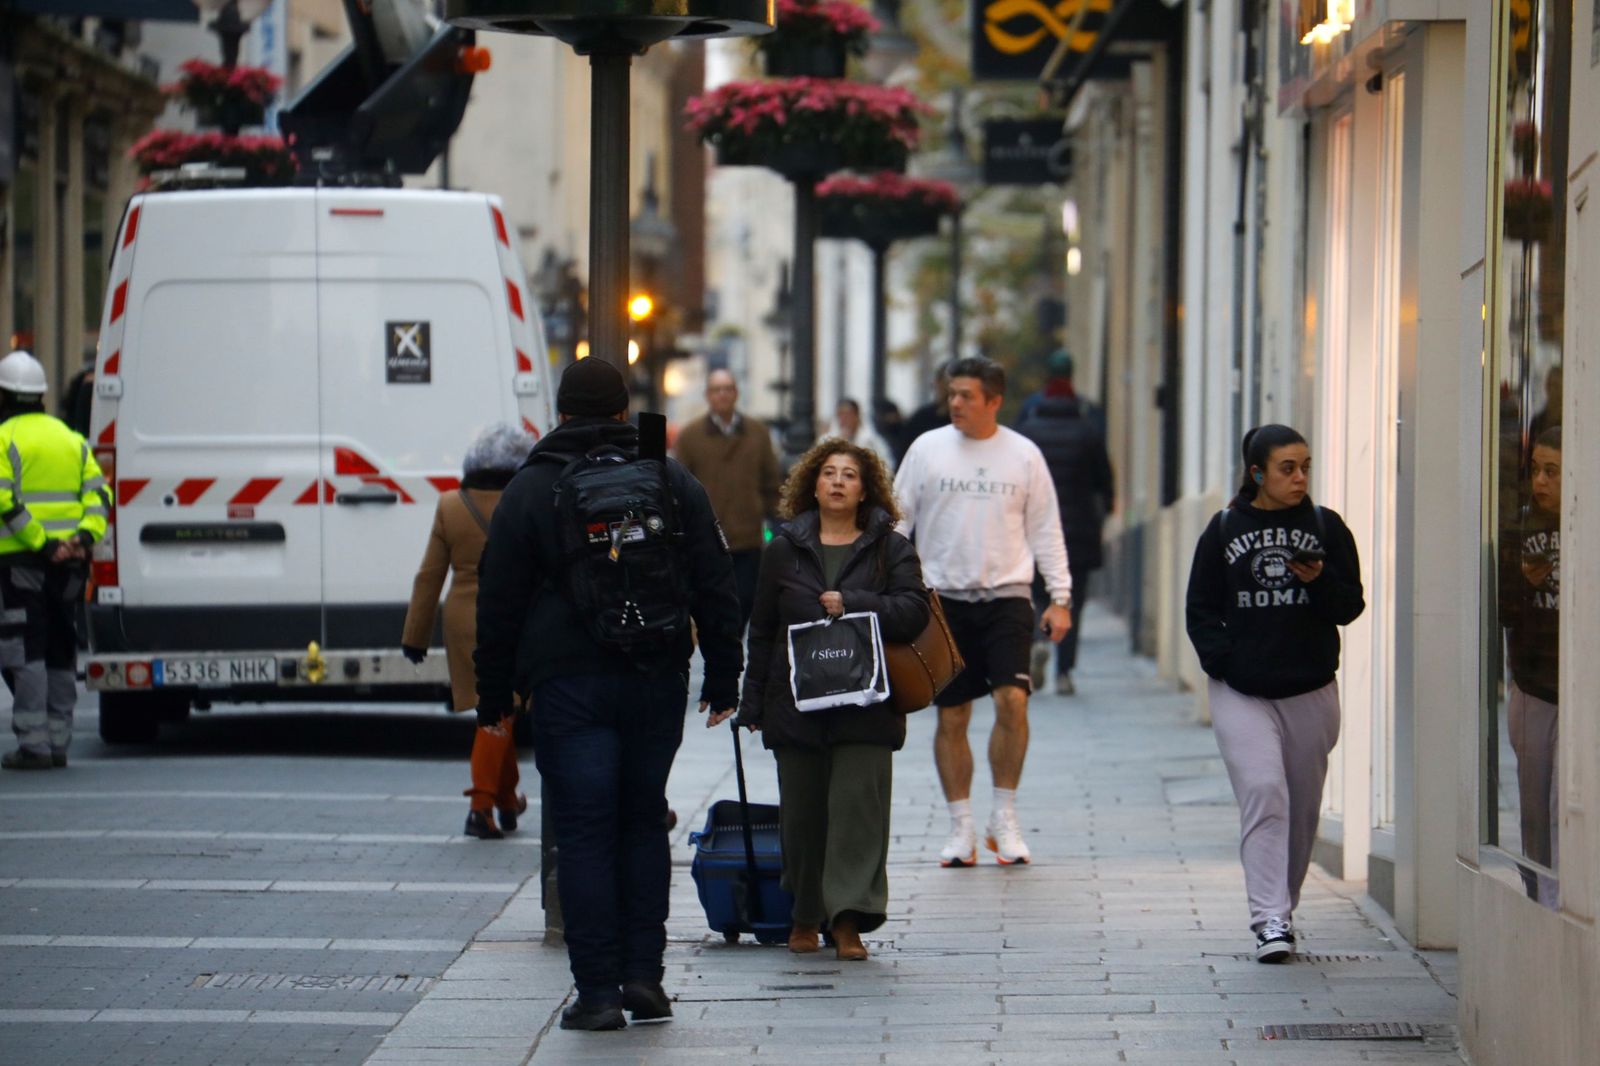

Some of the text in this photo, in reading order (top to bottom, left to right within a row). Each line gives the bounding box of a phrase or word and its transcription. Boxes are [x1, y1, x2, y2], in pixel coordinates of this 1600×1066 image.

[940, 478, 1018, 496] HACKETT
[1238, 588, 1310, 608] ROMA
[166, 660, 268, 680] 5336 NHK
